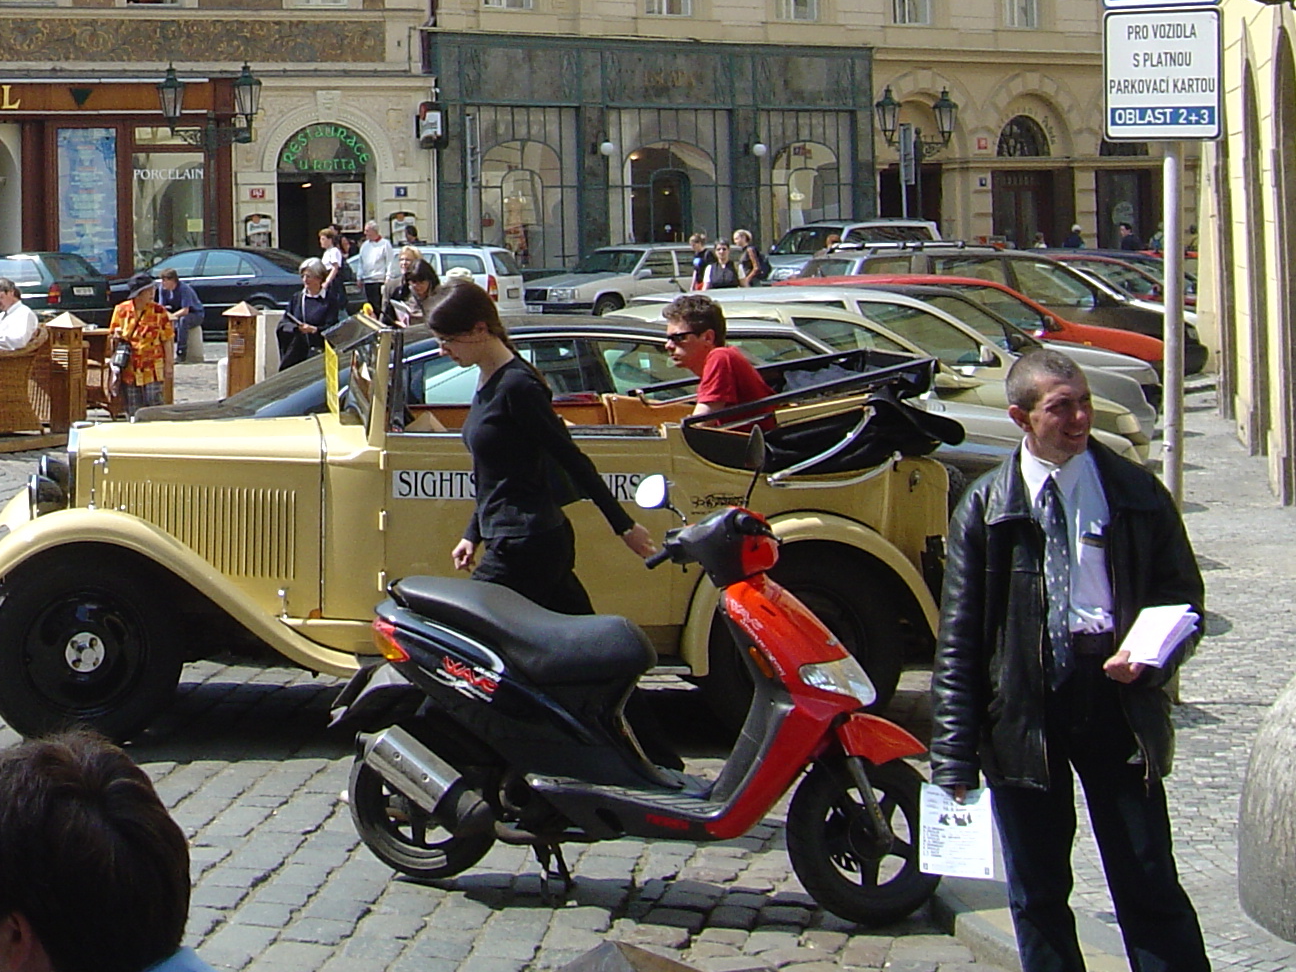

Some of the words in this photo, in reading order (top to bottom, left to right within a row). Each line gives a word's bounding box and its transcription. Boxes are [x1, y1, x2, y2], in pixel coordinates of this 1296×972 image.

[1127, 24, 1148, 40] PRO
[1152, 23, 1197, 39] VOZIDLA
[1133, 53, 1140, 68] S
[1143, 51, 1192, 67] PLATNOU
[1109, 76, 1170, 94] PARKOVACÍ
[1173, 77, 1215, 93] KARTOU
[1115, 109, 1173, 124] OBLAST
[1179, 109, 1209, 123] 2+3
[133, 168, 204, 180] PORCELAIN
